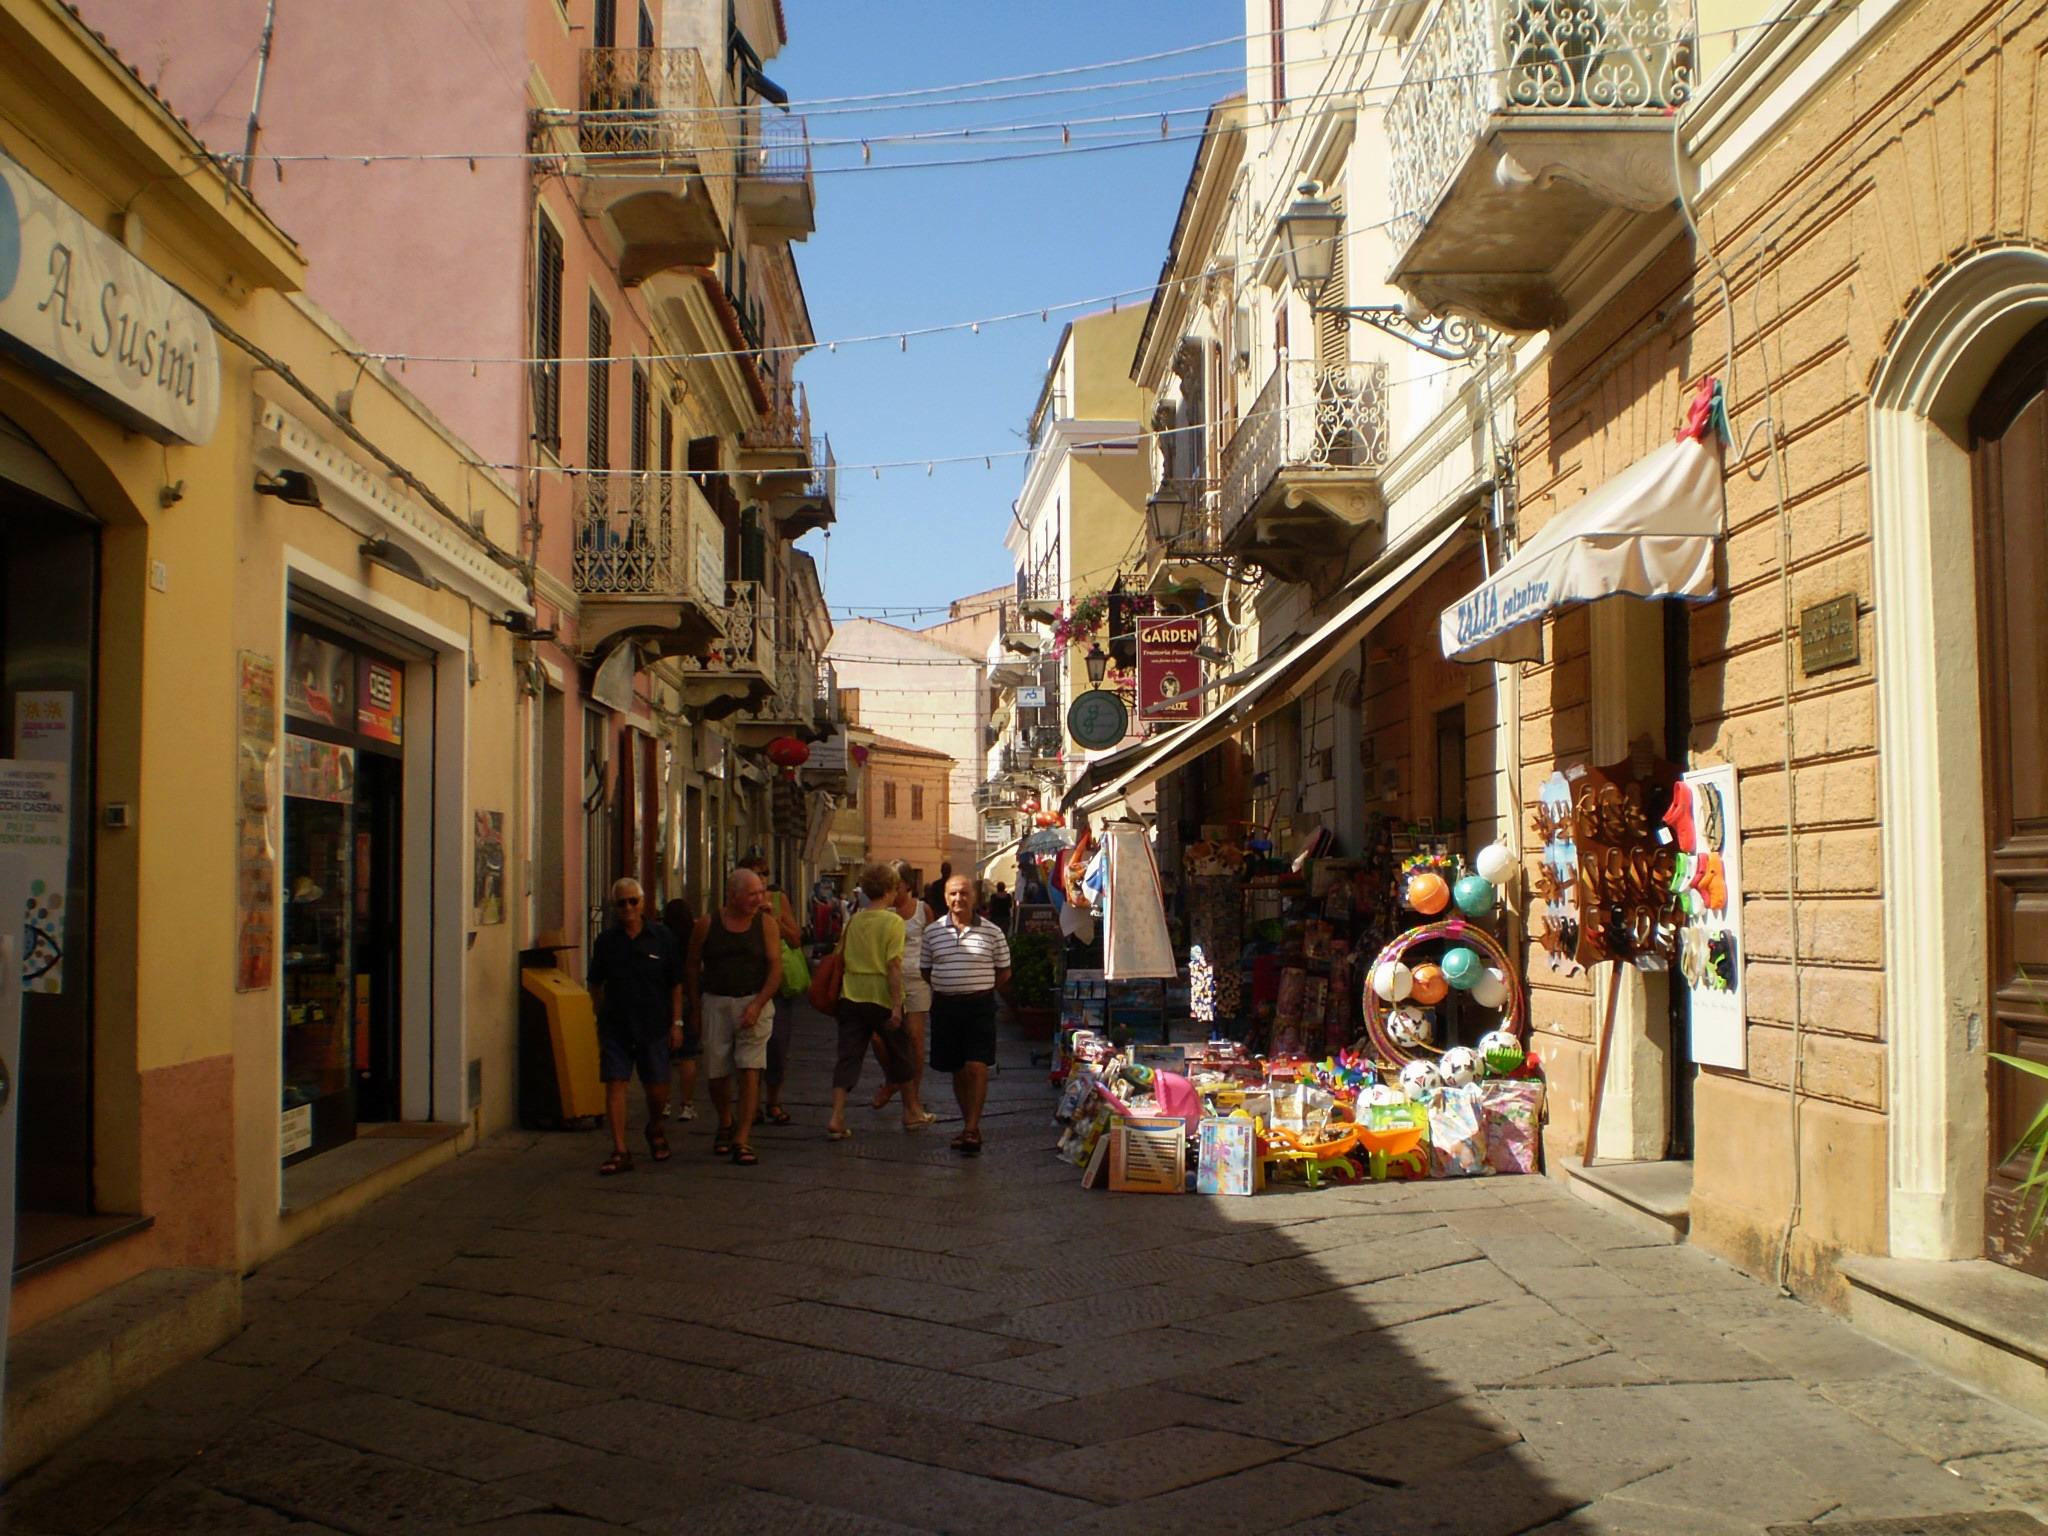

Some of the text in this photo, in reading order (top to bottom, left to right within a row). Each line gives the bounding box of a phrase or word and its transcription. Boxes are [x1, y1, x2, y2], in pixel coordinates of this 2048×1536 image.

[37, 242, 198, 406] A. Susini
[1141, 627, 1198, 643] GARDEN
[1457, 581, 1549, 645] TALIA calzature
